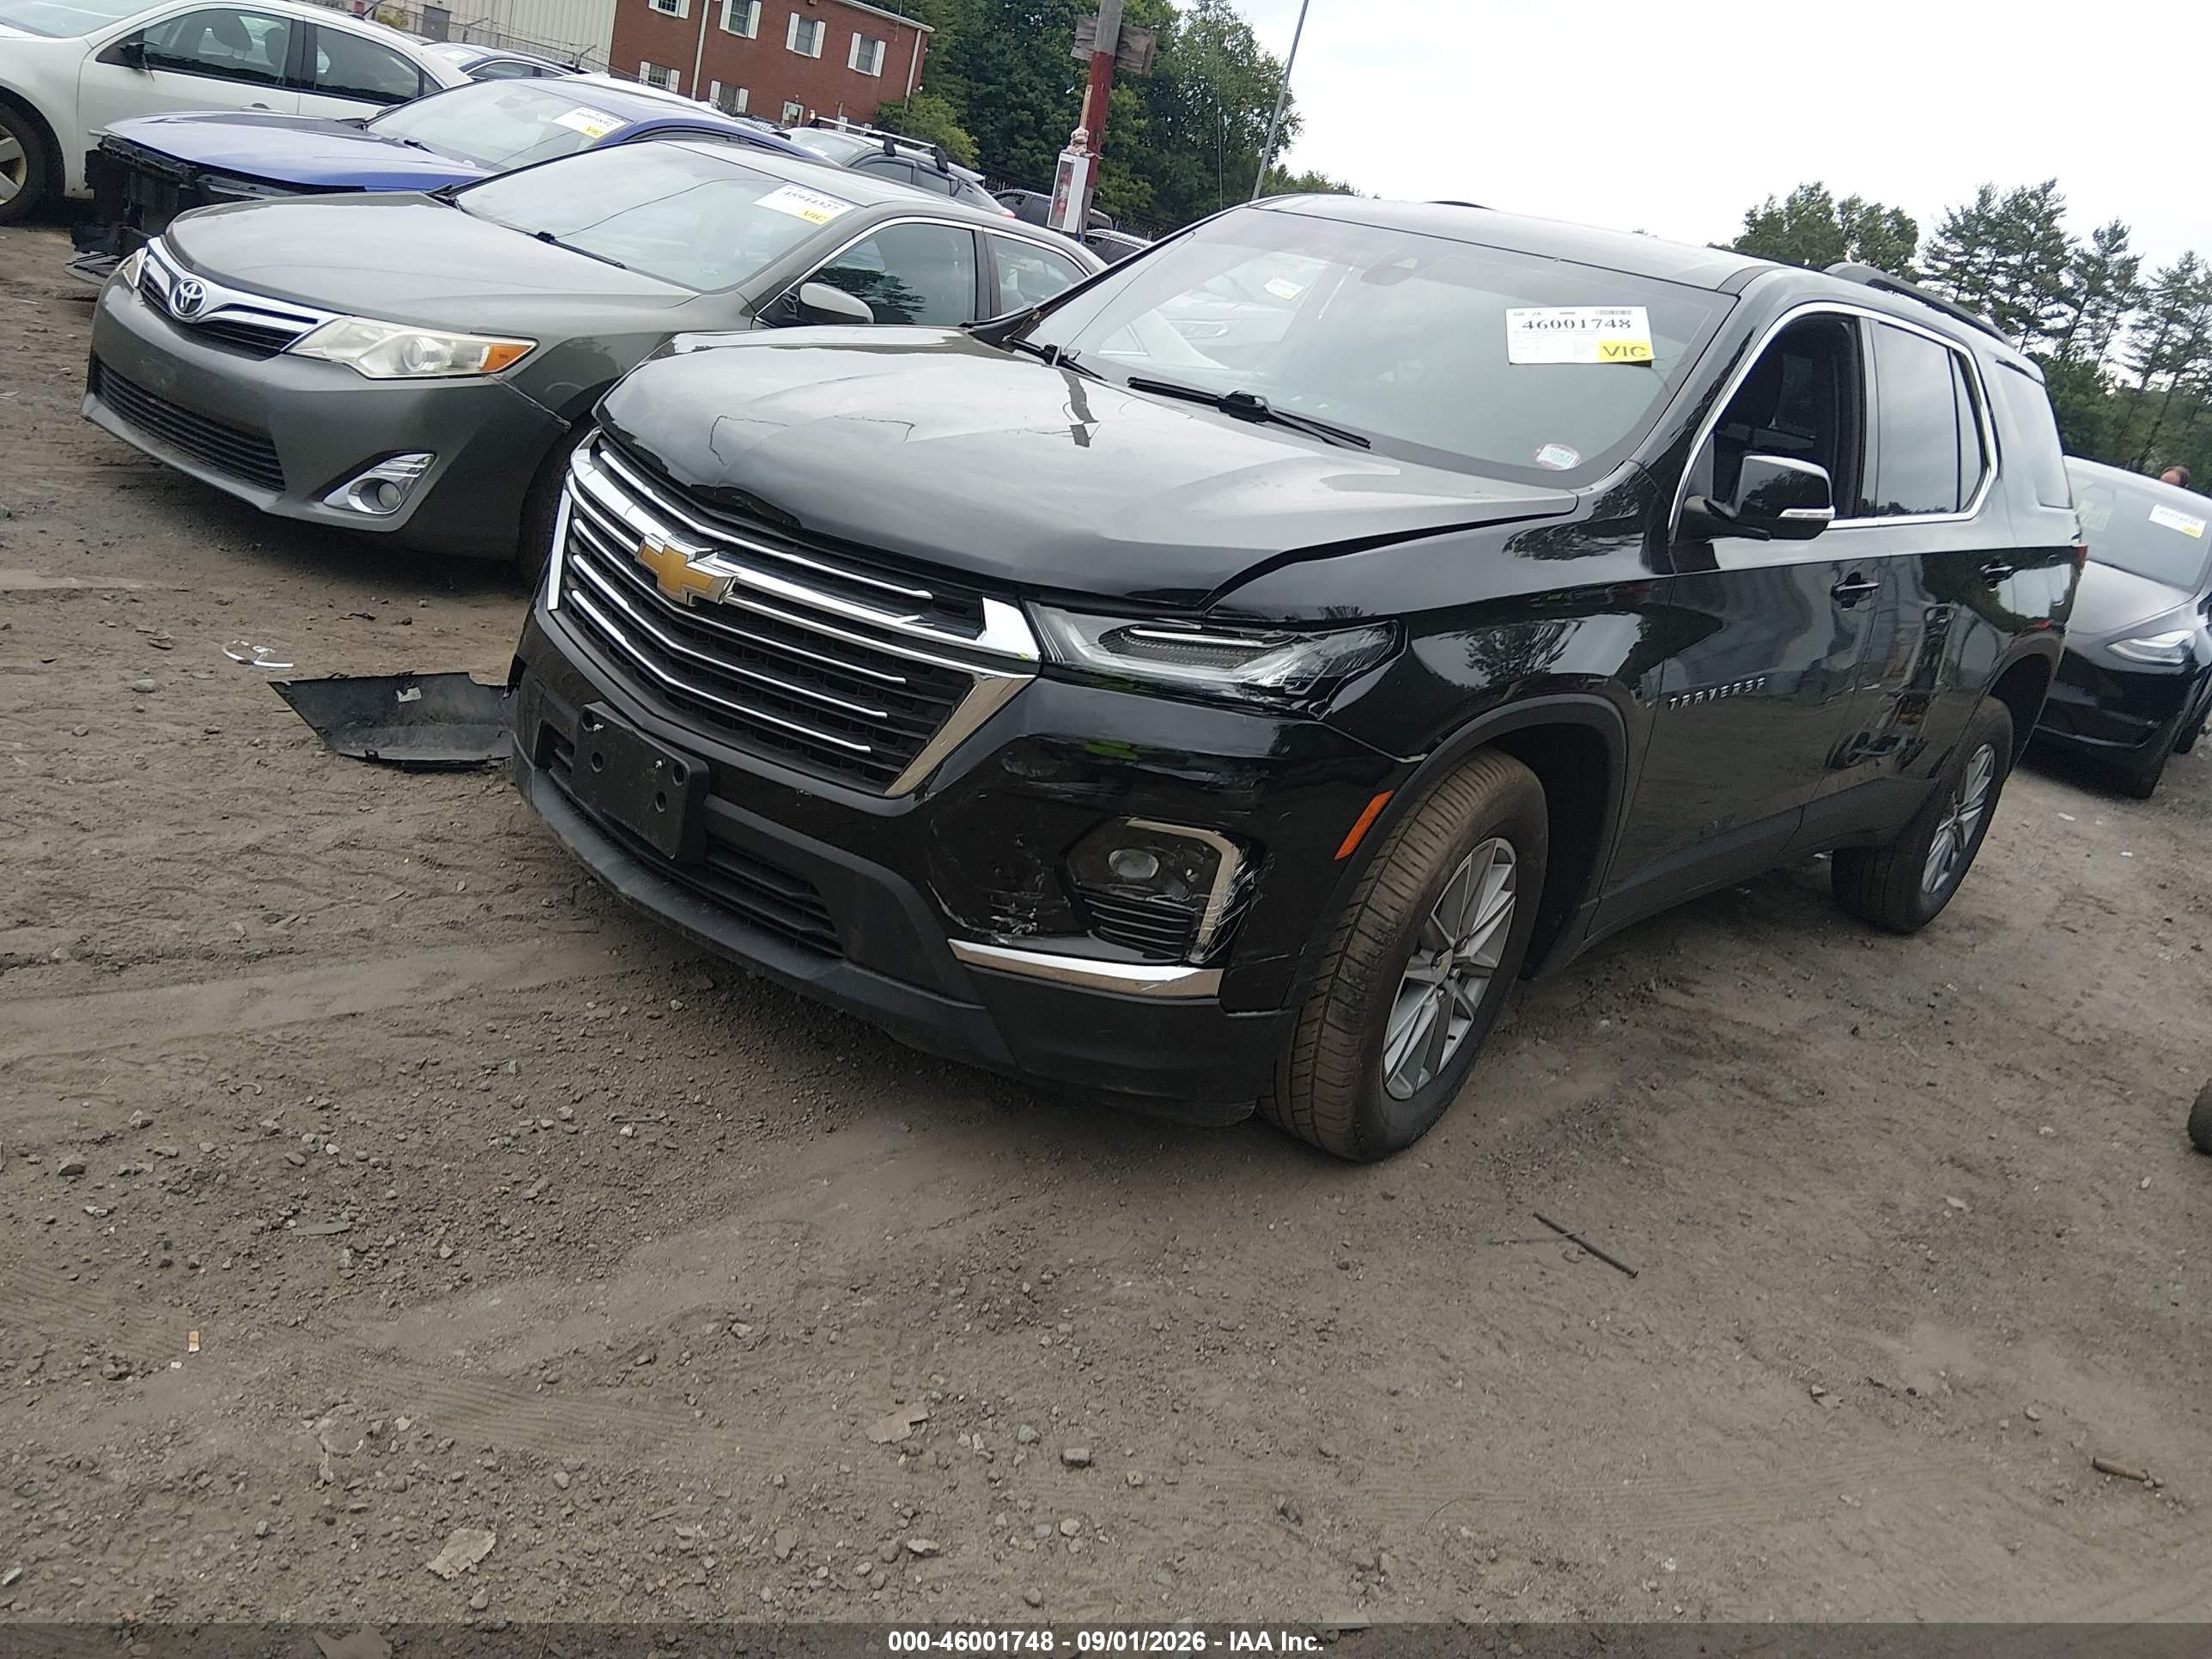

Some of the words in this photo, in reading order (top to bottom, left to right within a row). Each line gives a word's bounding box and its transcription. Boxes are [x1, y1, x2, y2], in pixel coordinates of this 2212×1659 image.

[803, 210, 828, 222] VIC
[1521, 318, 1632, 331] 46001748
[1602, 345, 1648, 357] VIC
[1668, 677, 1766, 712] TRAVERSE
